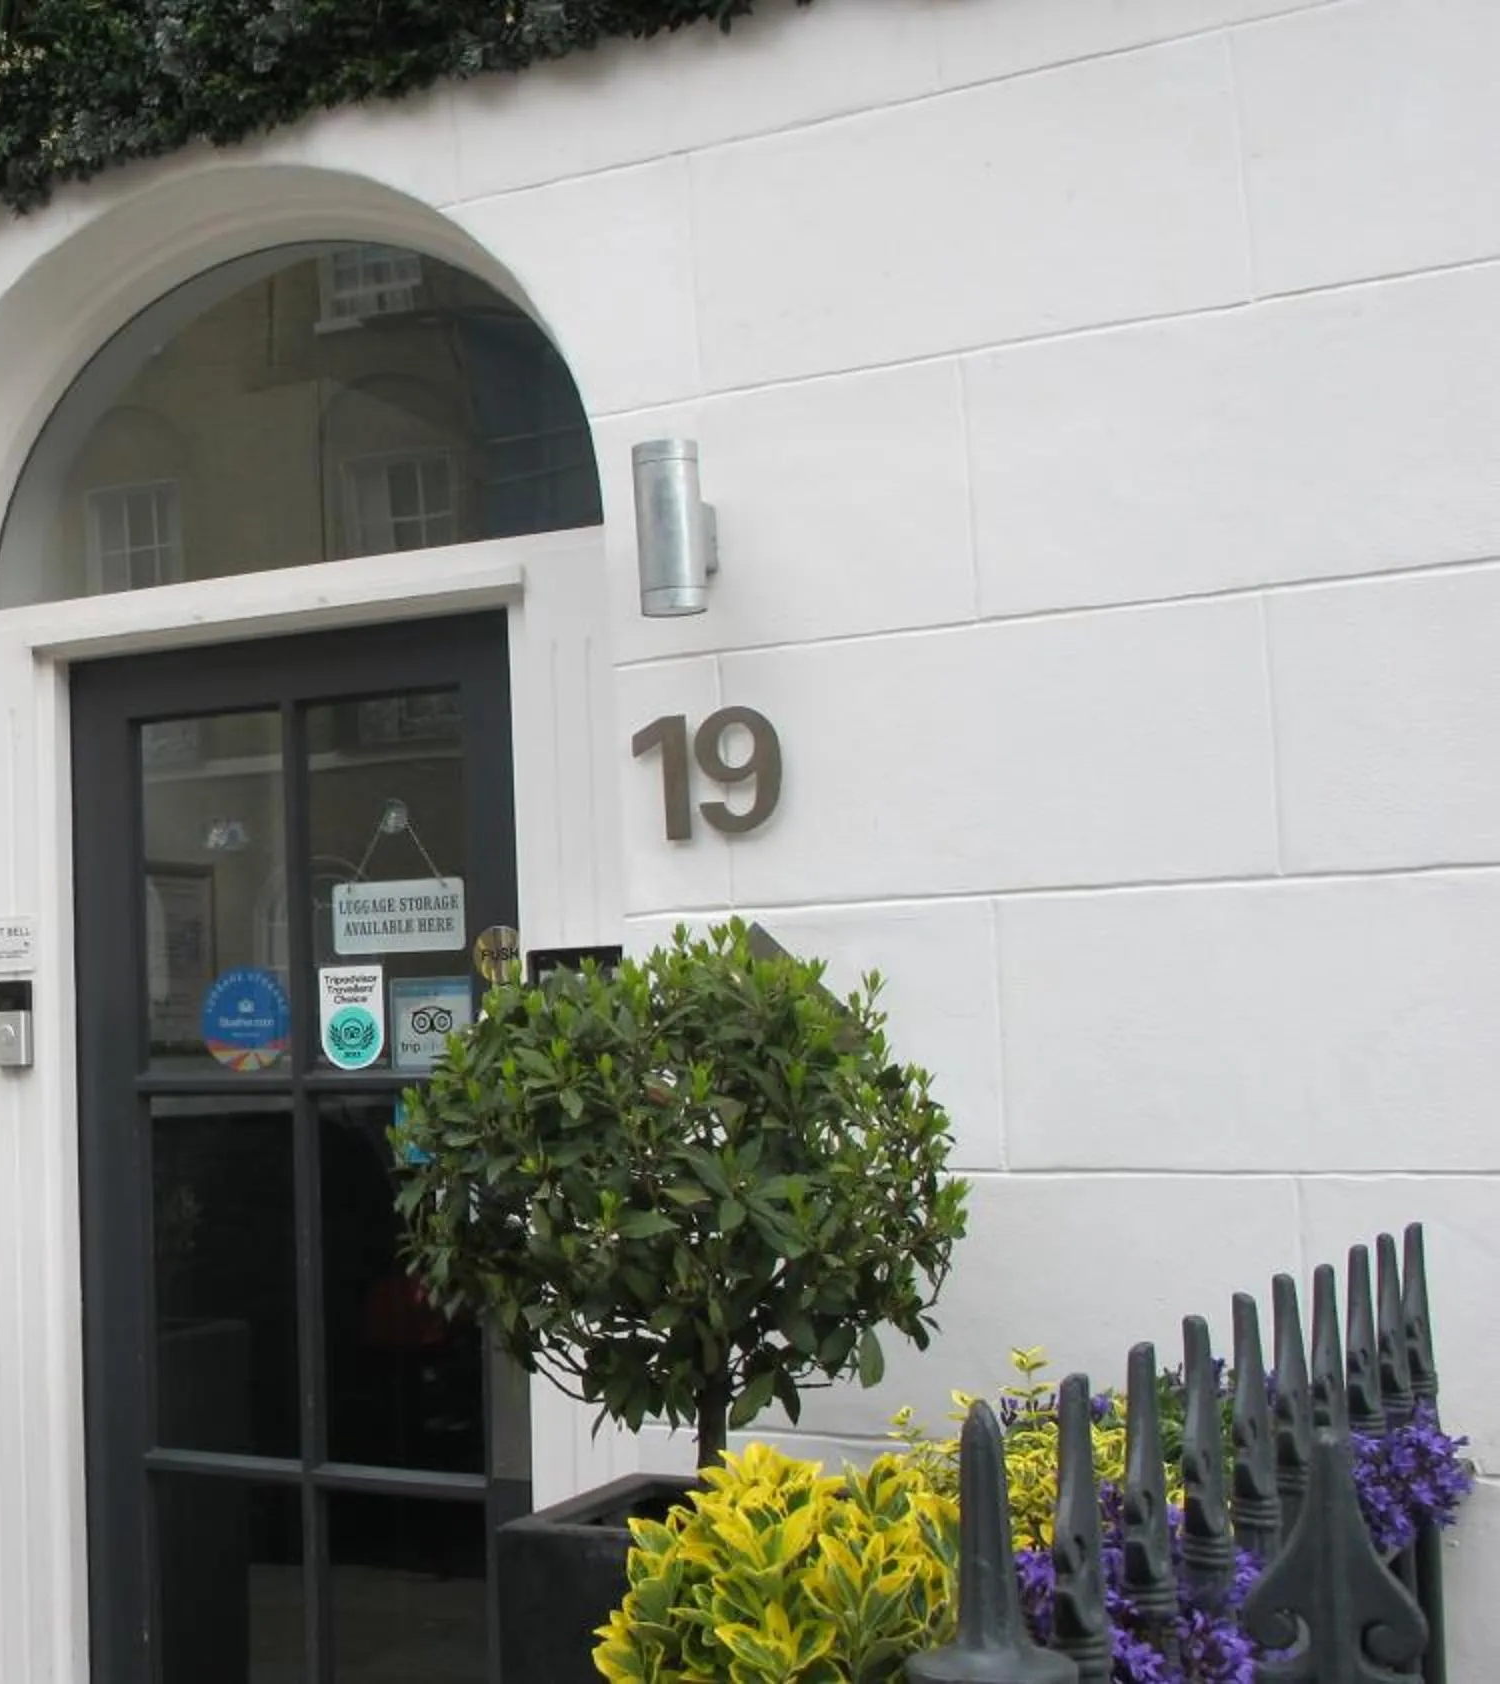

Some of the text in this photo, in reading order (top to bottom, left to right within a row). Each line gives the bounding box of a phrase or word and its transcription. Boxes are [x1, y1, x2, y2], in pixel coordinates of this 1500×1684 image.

[631, 705, 783, 841] 19
[338, 894, 460, 915] LUGGAGE STORAGE
[343, 917, 455, 936] AVAILABLE HERE
